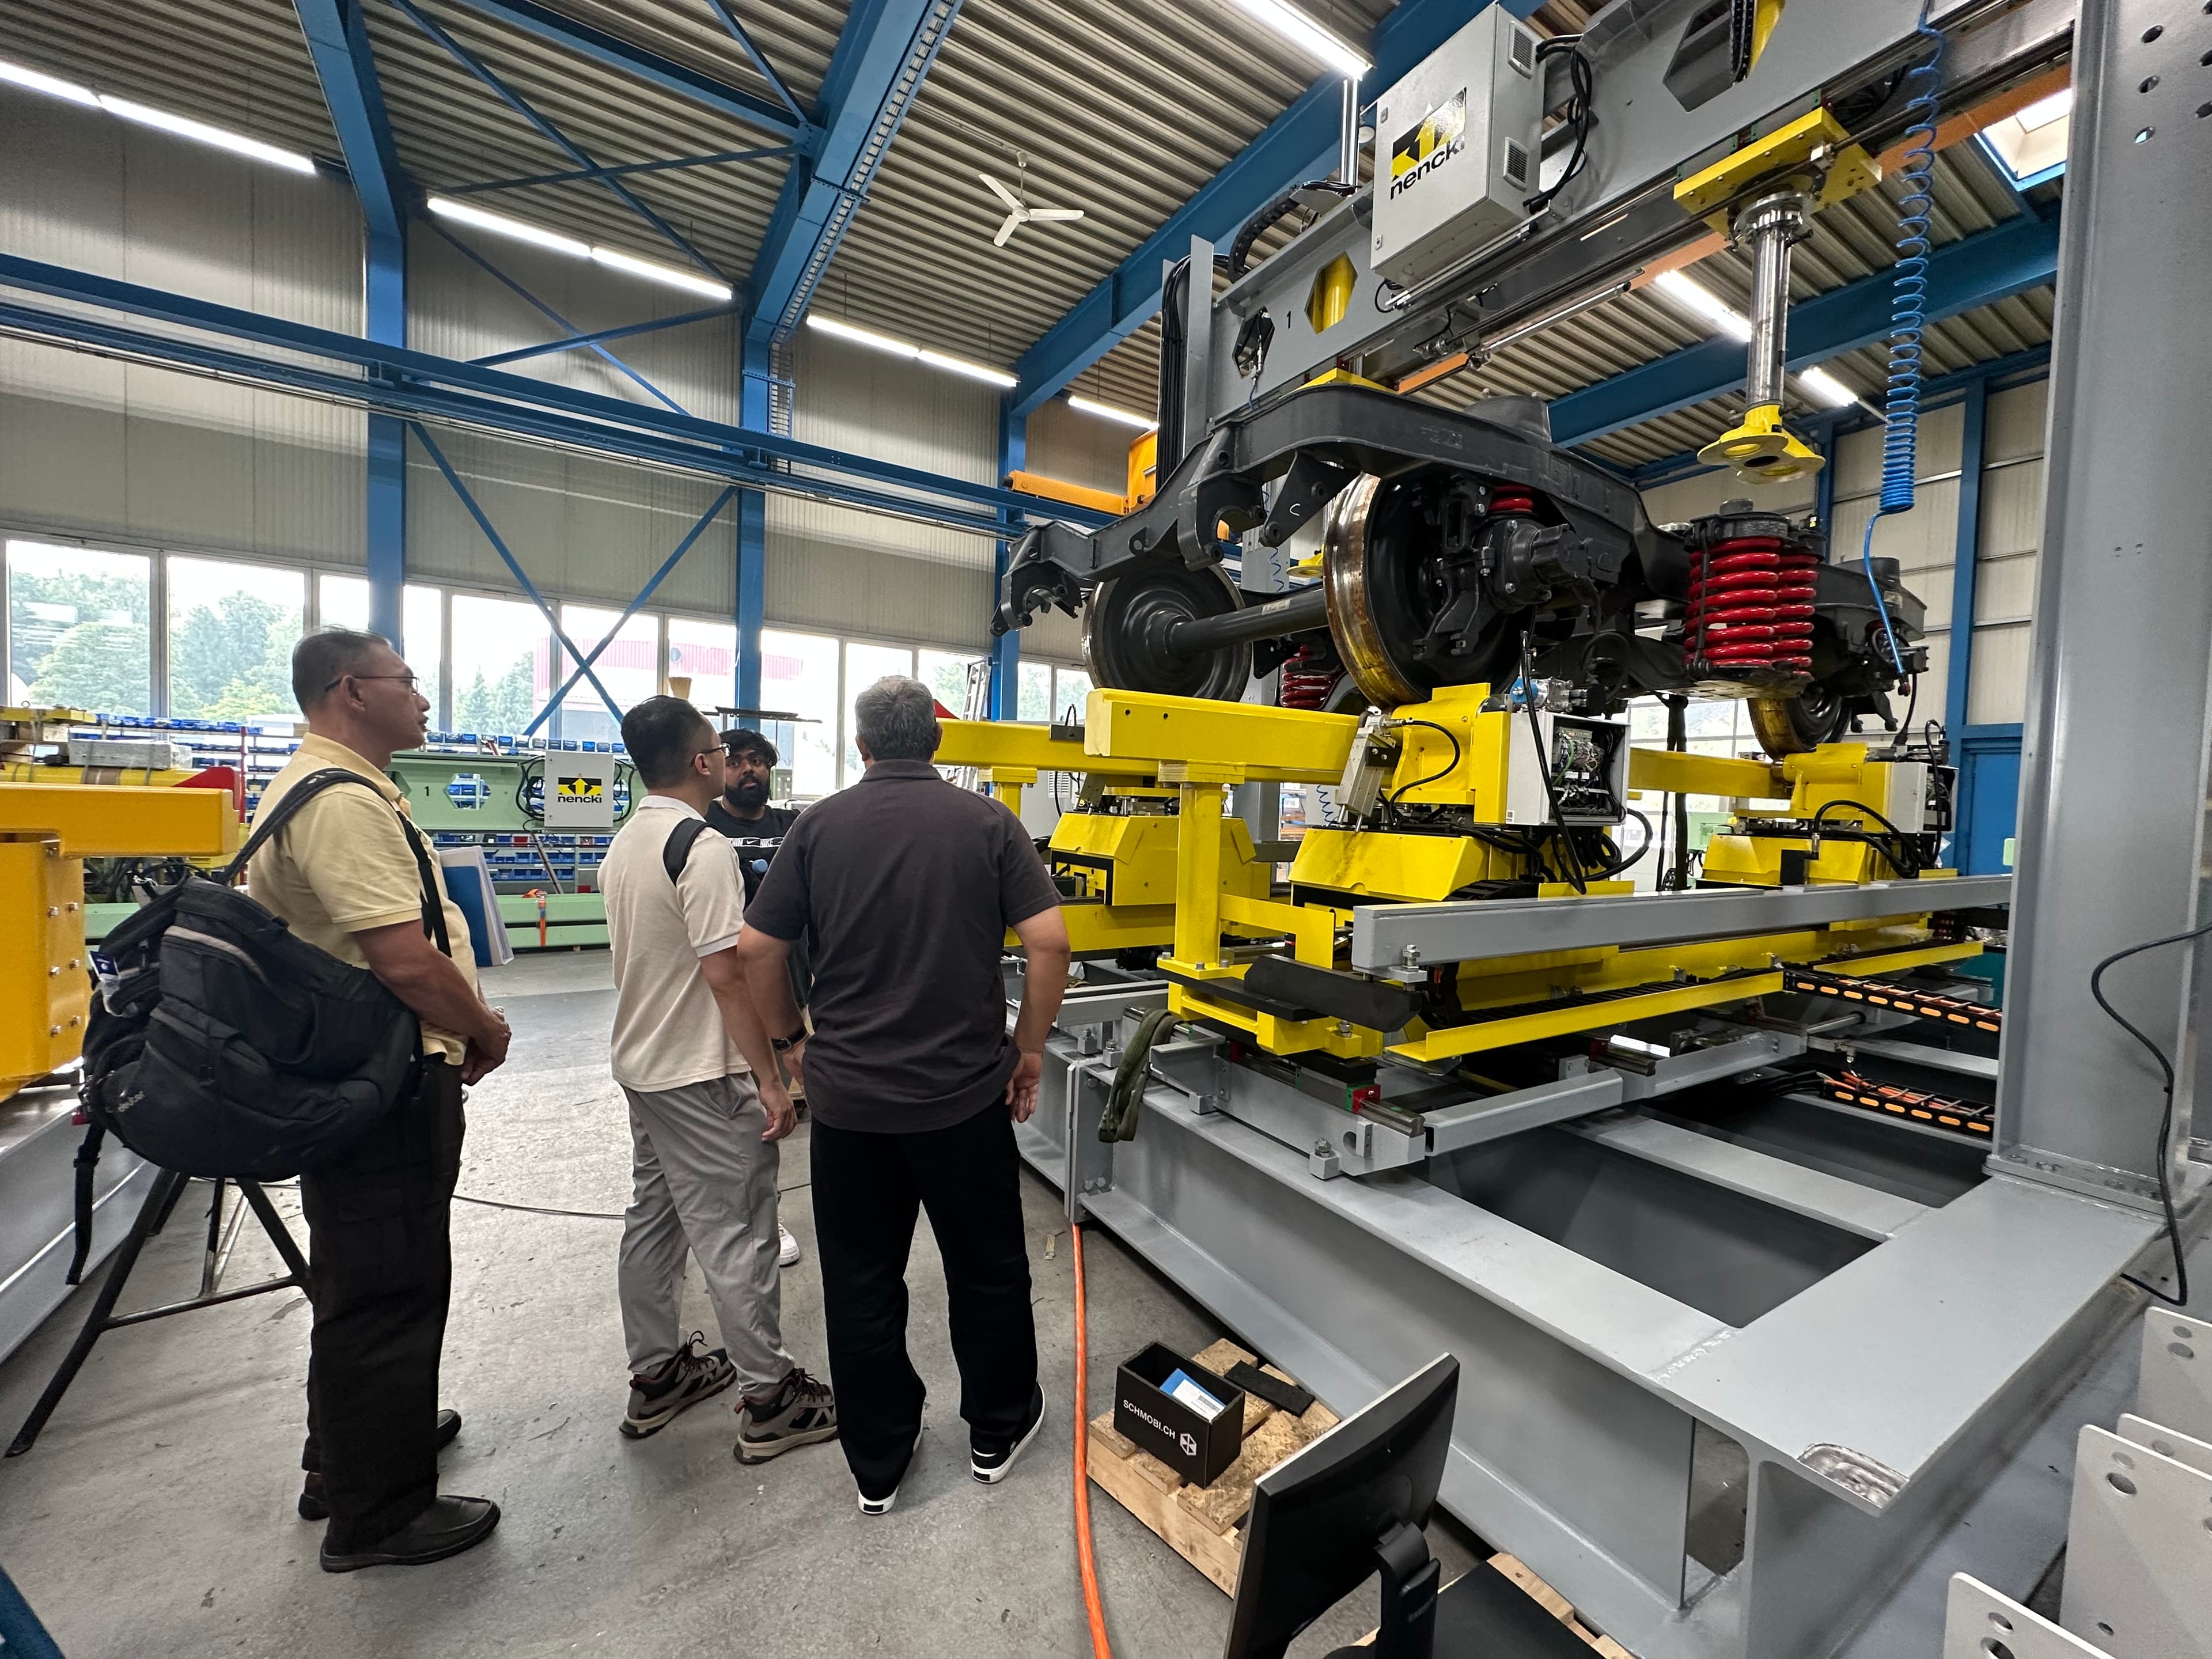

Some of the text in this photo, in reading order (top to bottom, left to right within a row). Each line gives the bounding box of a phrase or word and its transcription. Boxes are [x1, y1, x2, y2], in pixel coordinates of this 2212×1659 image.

[1390, 135, 1465, 200] nencki
[1286, 310, 1291, 329] 1
[425, 786, 429, 797] 1
[558, 795, 602, 803] nencki
[760, 839, 774, 847] NIKE
[1123, 1399, 1176, 1440] SCHMOBI.CH
